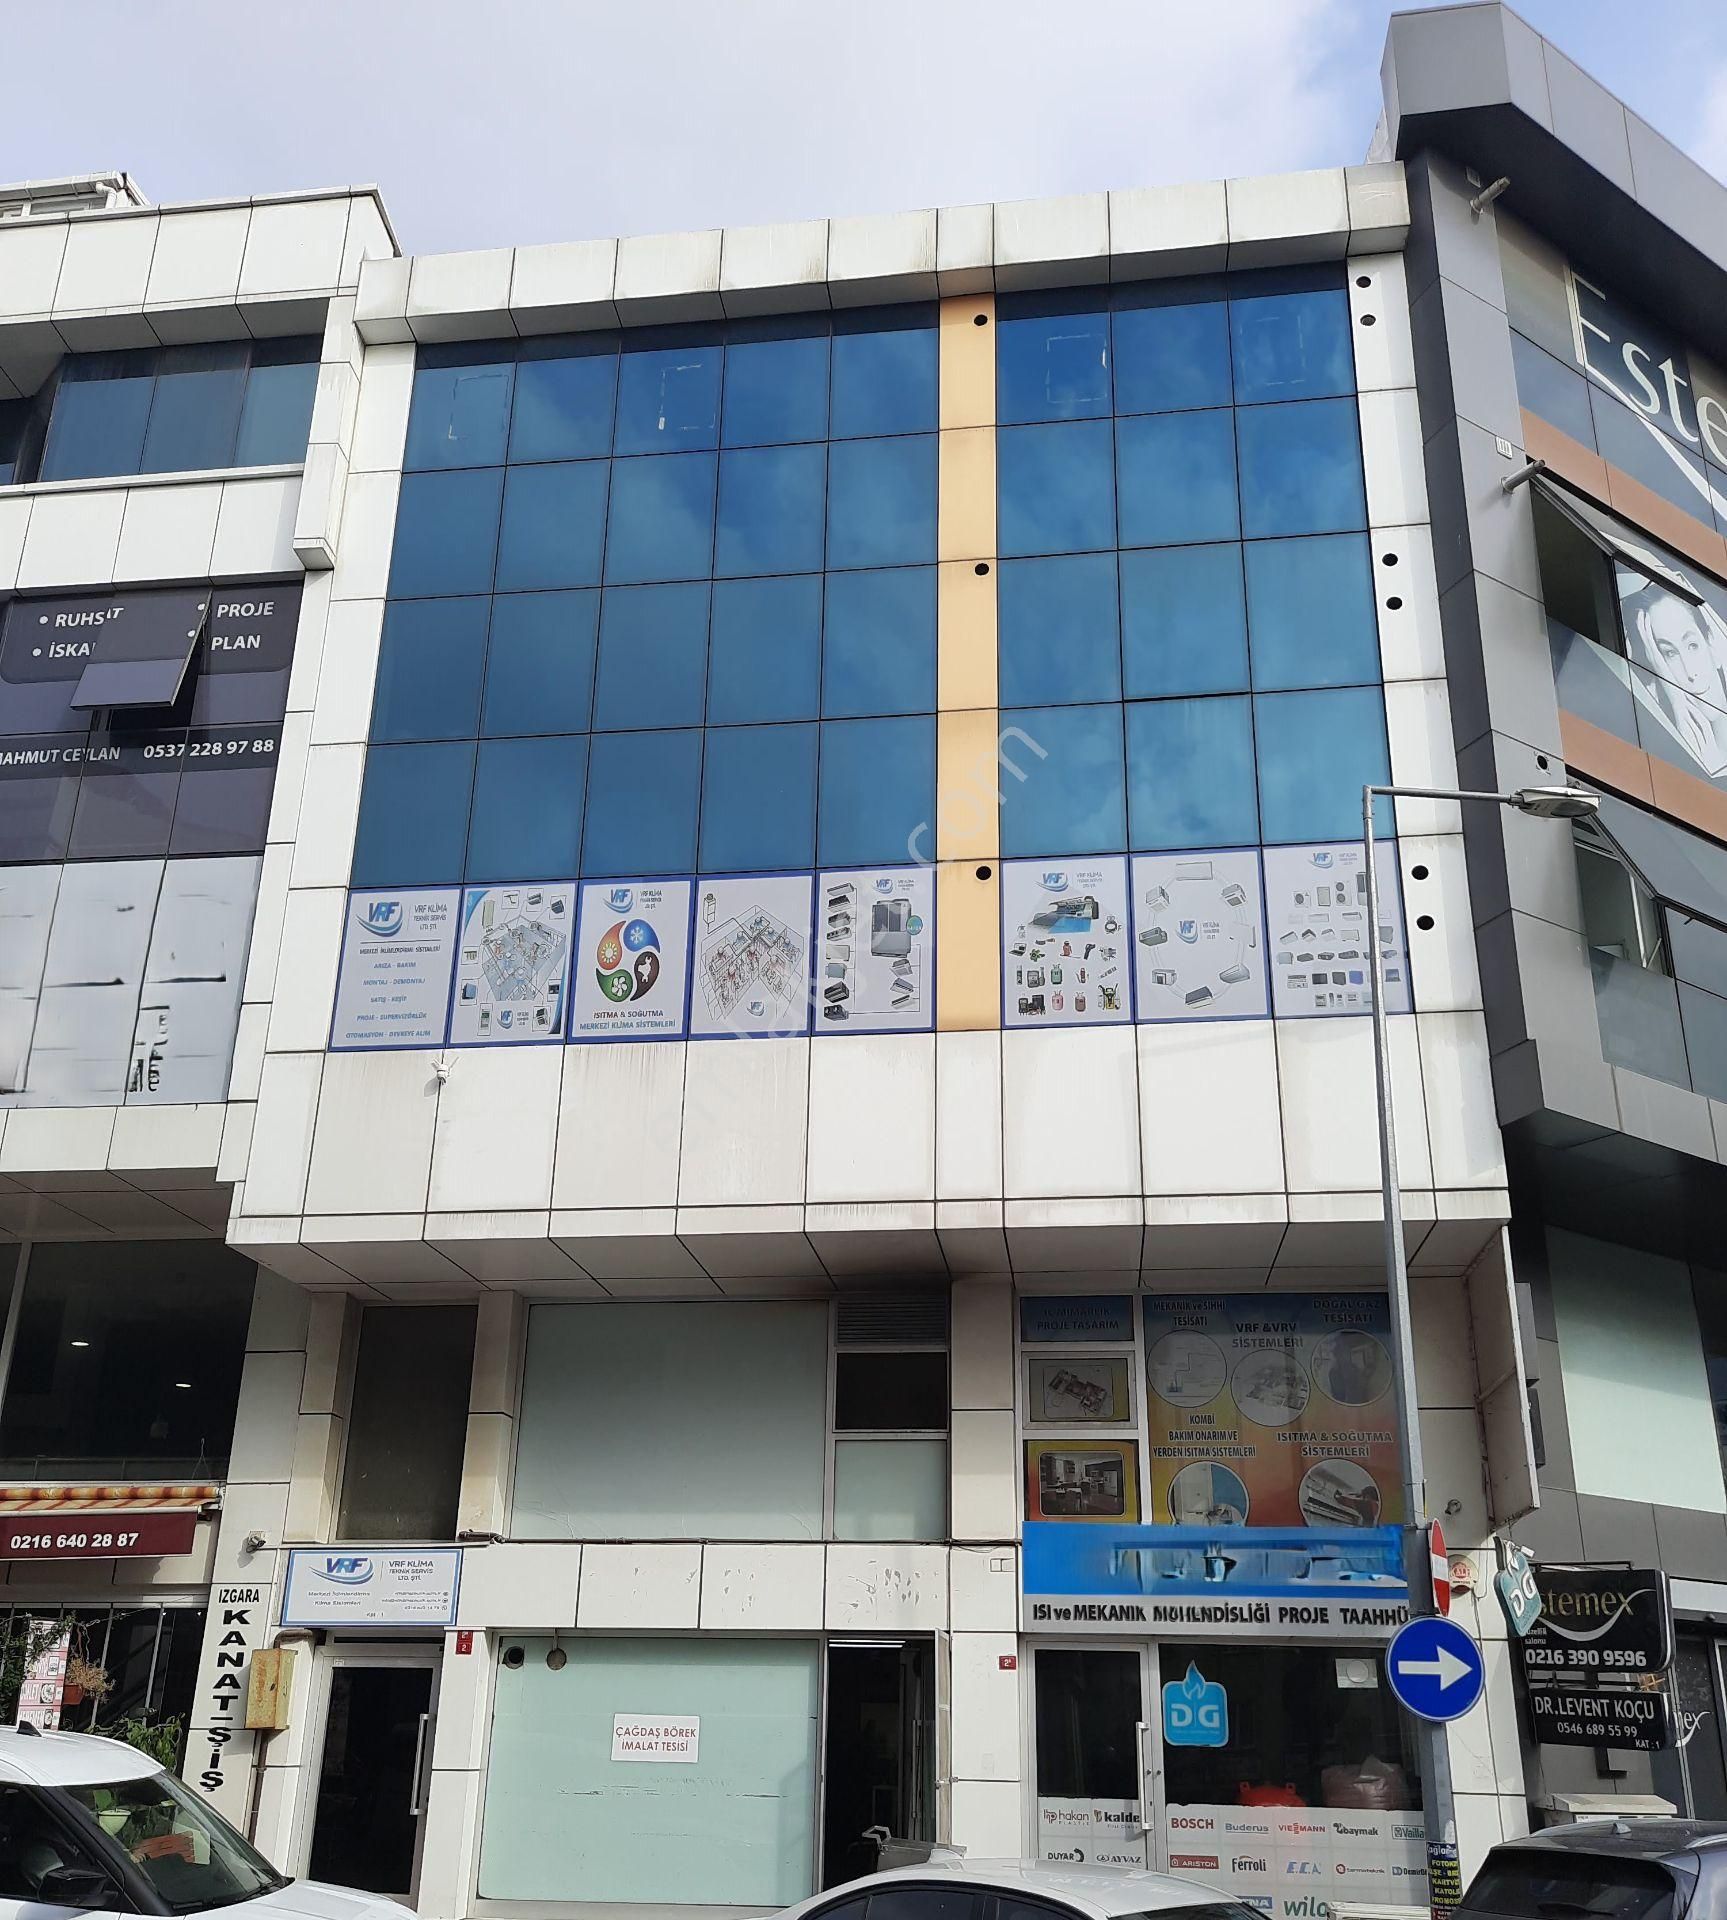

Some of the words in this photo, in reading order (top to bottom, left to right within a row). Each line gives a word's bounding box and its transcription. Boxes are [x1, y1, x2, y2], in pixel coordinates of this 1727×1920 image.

[217, 601, 275, 618] PROJE
[49, 642, 96, 658] İSKA
[211, 635, 261, 651] PLAN
[143, 744, 185, 759] 0537
[190, 742, 223, 756] 228
[226, 740, 248, 755] 97
[252, 739, 274, 753] 88
[610, 889, 630, 903] VRF
[369, 902, 400, 922] VRF
[1236, 1323, 1259, 1332] VRF
[1189, 1413, 1215, 1425] KOMBİ
[1169, 1431, 1193, 1441] BAKIM
[1195, 1431, 1227, 1441] ONARIM
[1228, 1431, 1238, 1441] VE
[1277, 1432, 1317, 1442] ISITMA
[1320, 1432, 1329, 1441] &
[1332, 1430, 1392, 1442] SOĞUTMA
[1153, 1447, 1183, 1457] YERDEN
[1184, 1447, 1211, 1457] ISITMA
[1302, 1445, 1369, 1457] SİSTEMLERİ
[10, 1534, 51, 1549] 0216
[56, 1534, 87, 1548] 640
[91, 1533, 113, 1548] 28
[116, 1533, 139, 1547] 87
[326, 1557, 369, 1574] VRF
[389, 1560, 406, 1568] VRF
[407, 1559, 434, 1568] KLİMA
[218, 1588, 260, 1604] IZGARA
[1033, 1604, 1051, 1621] ISI
[1053, 1607, 1072, 1620] ve
[1278, 1606, 1329, 1624] PROJE
[461, 1644, 467, 1652] 2
[1525, 1649, 1564, 1666] 0216
[1567, 1650, 1600, 1666] 390
[1602, 1650, 1647, 1667] 9596
[1534, 1696, 1610, 1718] DR.LEVENT
[1613, 1700, 1655, 1724] KOÇU
[615, 1725, 661, 1739] ÇAĞDAŞ
[663, 1725, 697, 1738] BÖREK
[1557, 1722, 1583, 1735] 0546
[1586, 1723, 1605, 1736] 689
[1608, 1725, 1621, 1737] 55
[1624, 1726, 1637, 1738] 99
[621, 1738, 659, 1751] İMALAT
[661, 1740, 689, 1752] TESİSİ
[1635, 1739, 1650, 1749] KAT
[1059, 1809, 1089, 1821] hakan
[1104, 1811, 1140, 1823] kalde
[1171, 1818, 1214, 1830] BOSCH
[1225, 1823, 1269, 1832] Buderus
[1343, 1826, 1379, 1836] baymak
[1047, 1852, 1075, 1861] DUYAR
[1110, 1855, 1143, 1864] AYVAZ
[1182, 1860, 1216, 1868] ARISTON
[1232, 1857, 1267, 1873] Ferroli
[1284, 1896, 1328, 1917] wilo
